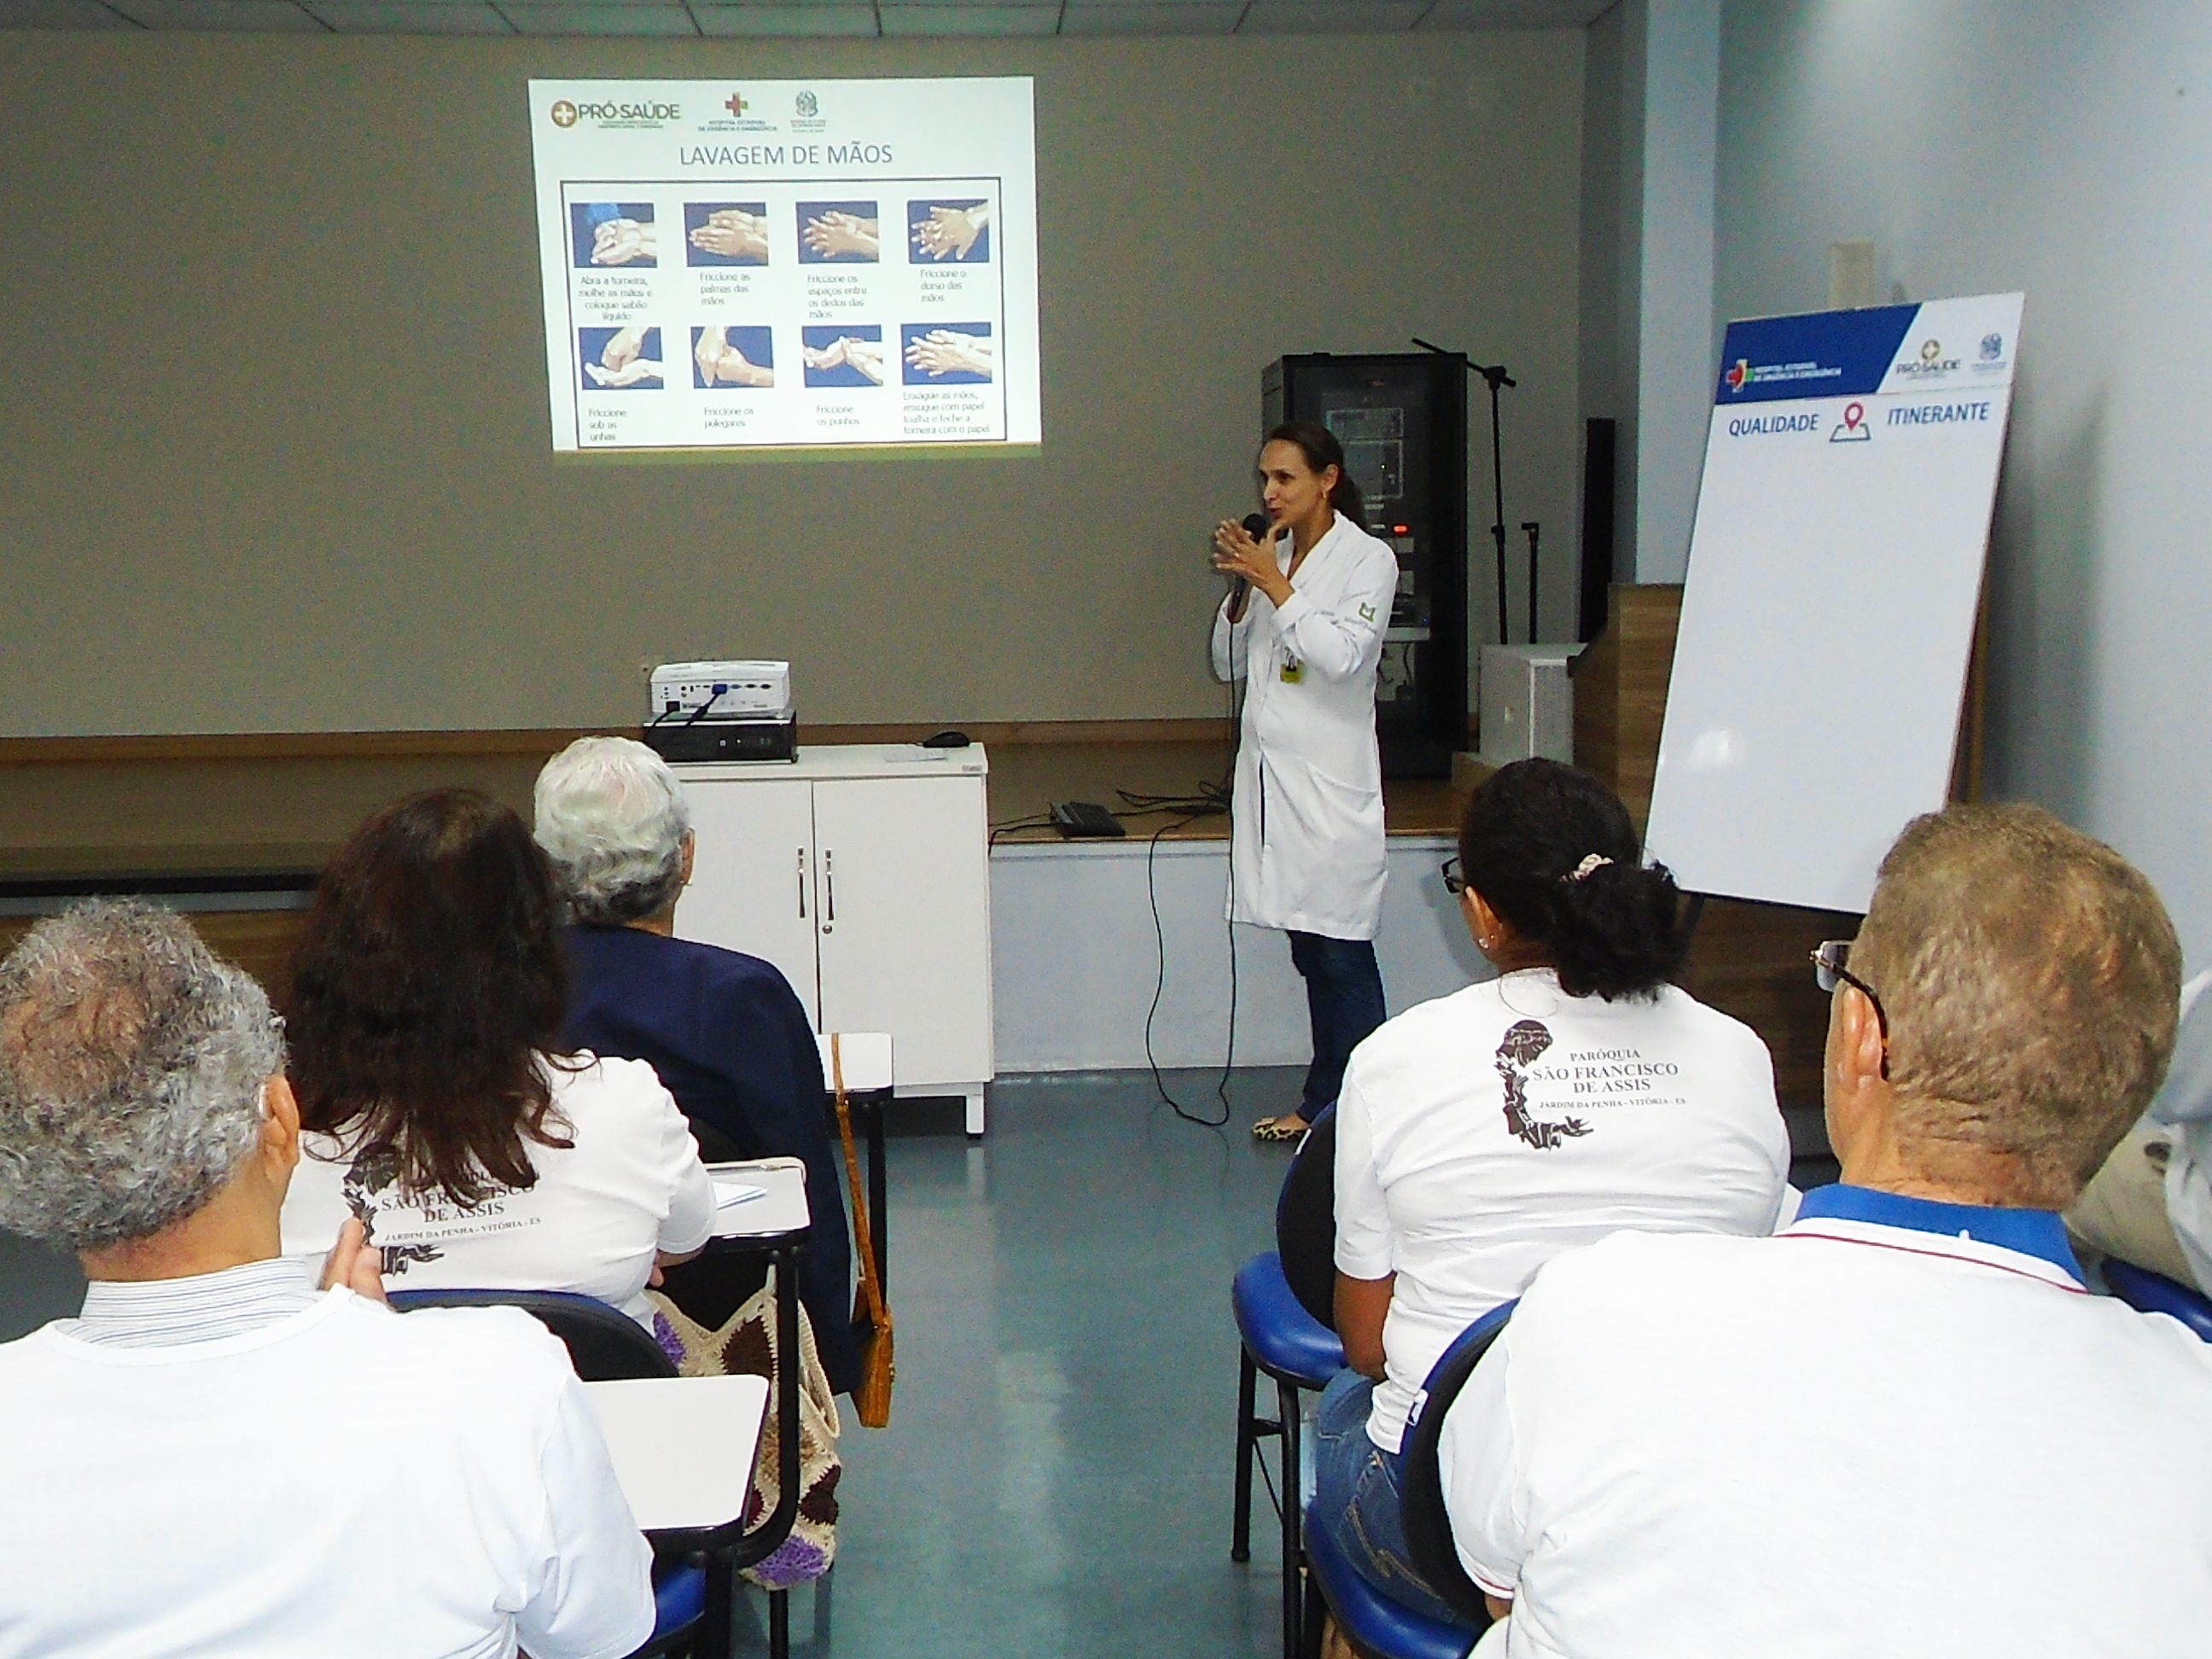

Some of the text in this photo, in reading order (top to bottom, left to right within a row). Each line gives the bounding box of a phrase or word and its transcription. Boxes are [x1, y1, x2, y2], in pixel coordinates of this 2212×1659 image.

[680, 141, 893, 166] LAVAGEM DE MÃOS
[1887, 402, 1990, 426] ITINERANTE
[1729, 414, 1819, 437] QUALIDADE
[1569, 1049, 1640, 1063] PARÓQUIA
[1532, 1062, 1679, 1081] SÃO FRANCISCO
[1574, 1079, 1651, 1094] DE ASSIS
[1592, 1100, 1622, 1109] PENHA
[1630, 1097, 1668, 1107] VITÓRIA
[381, 1194, 420, 1212] SÃO
[423, 1201, 504, 1223] DE ASSIS
[385, 1231, 423, 1242] JARDIM
[441, 1225, 474, 1237] PENHA
[481, 1220, 522, 1233] VITÓRIA
